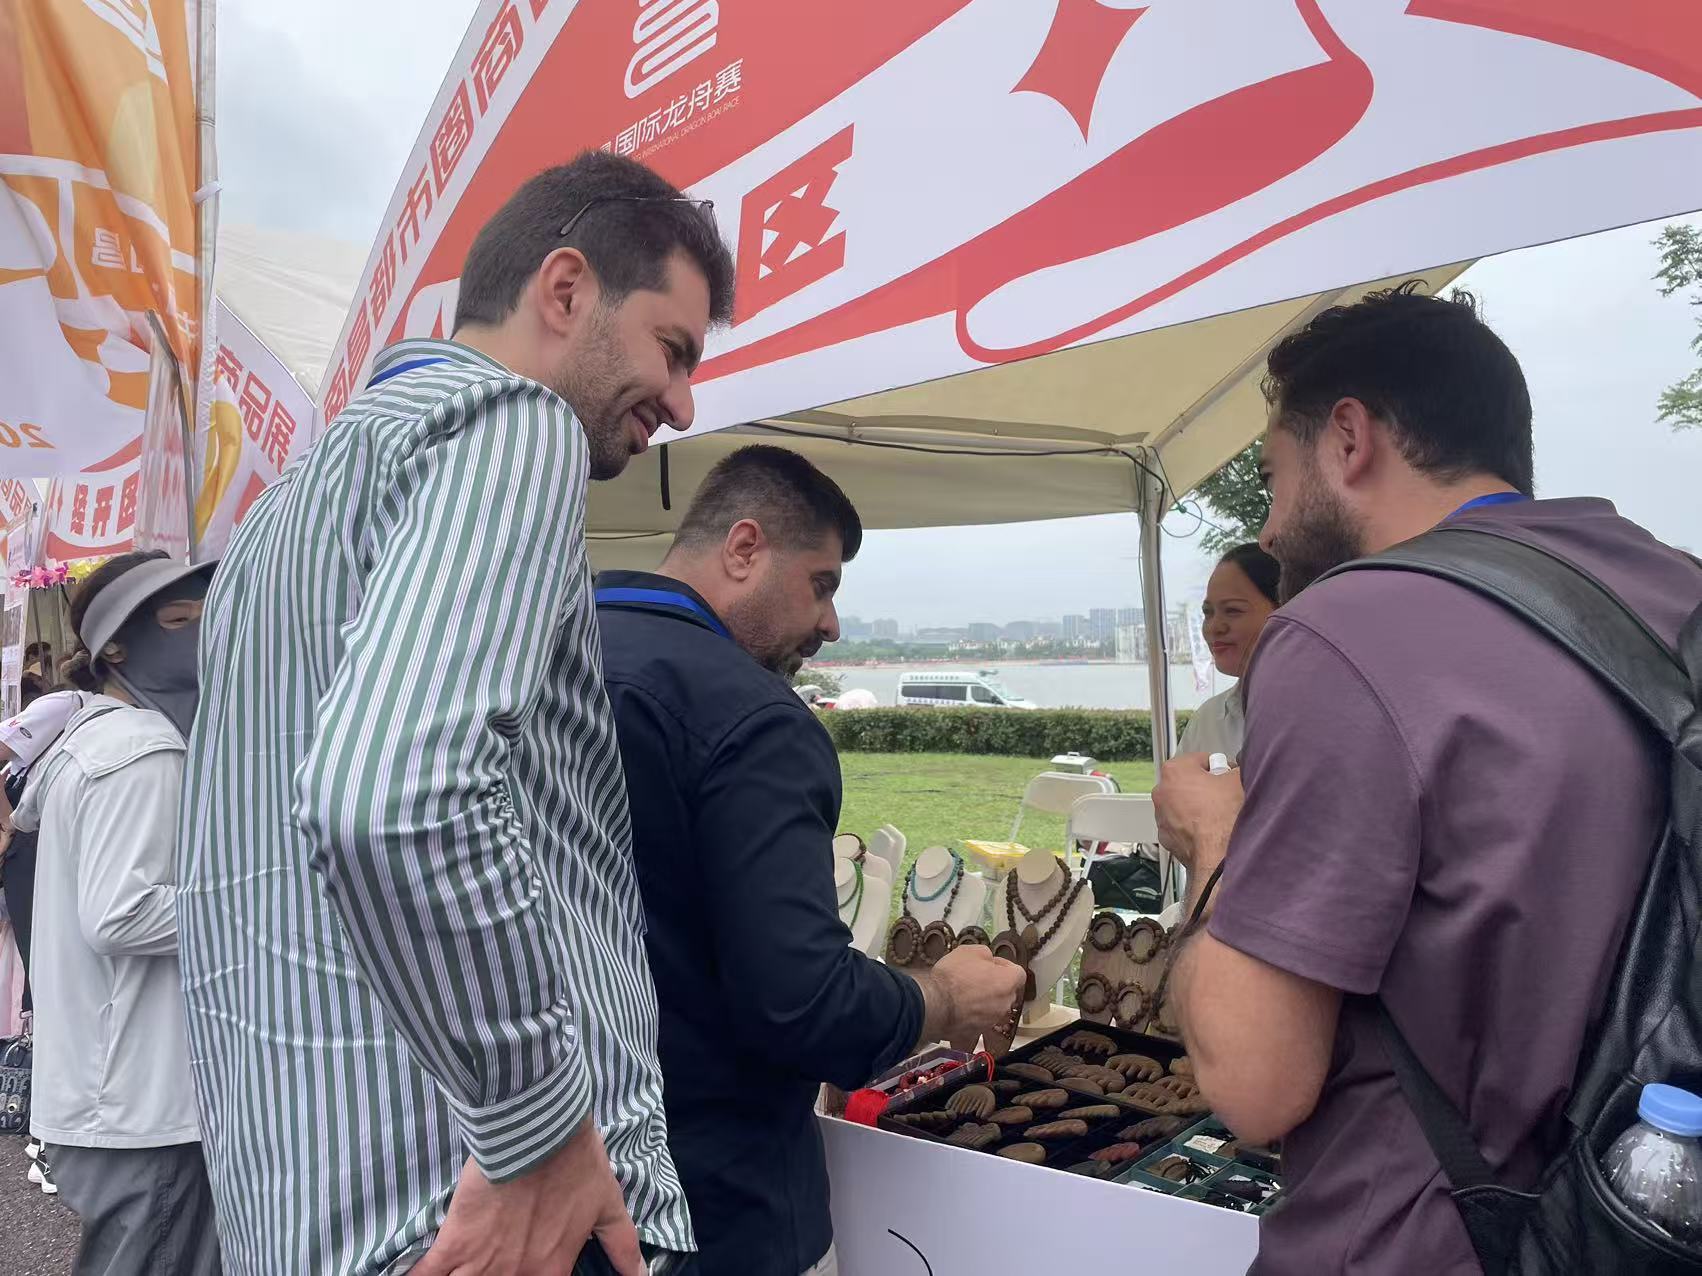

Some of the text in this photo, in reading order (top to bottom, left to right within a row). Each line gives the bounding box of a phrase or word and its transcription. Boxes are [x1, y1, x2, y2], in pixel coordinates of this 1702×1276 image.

[323, 0, 549, 428] 南昌都市圈商
